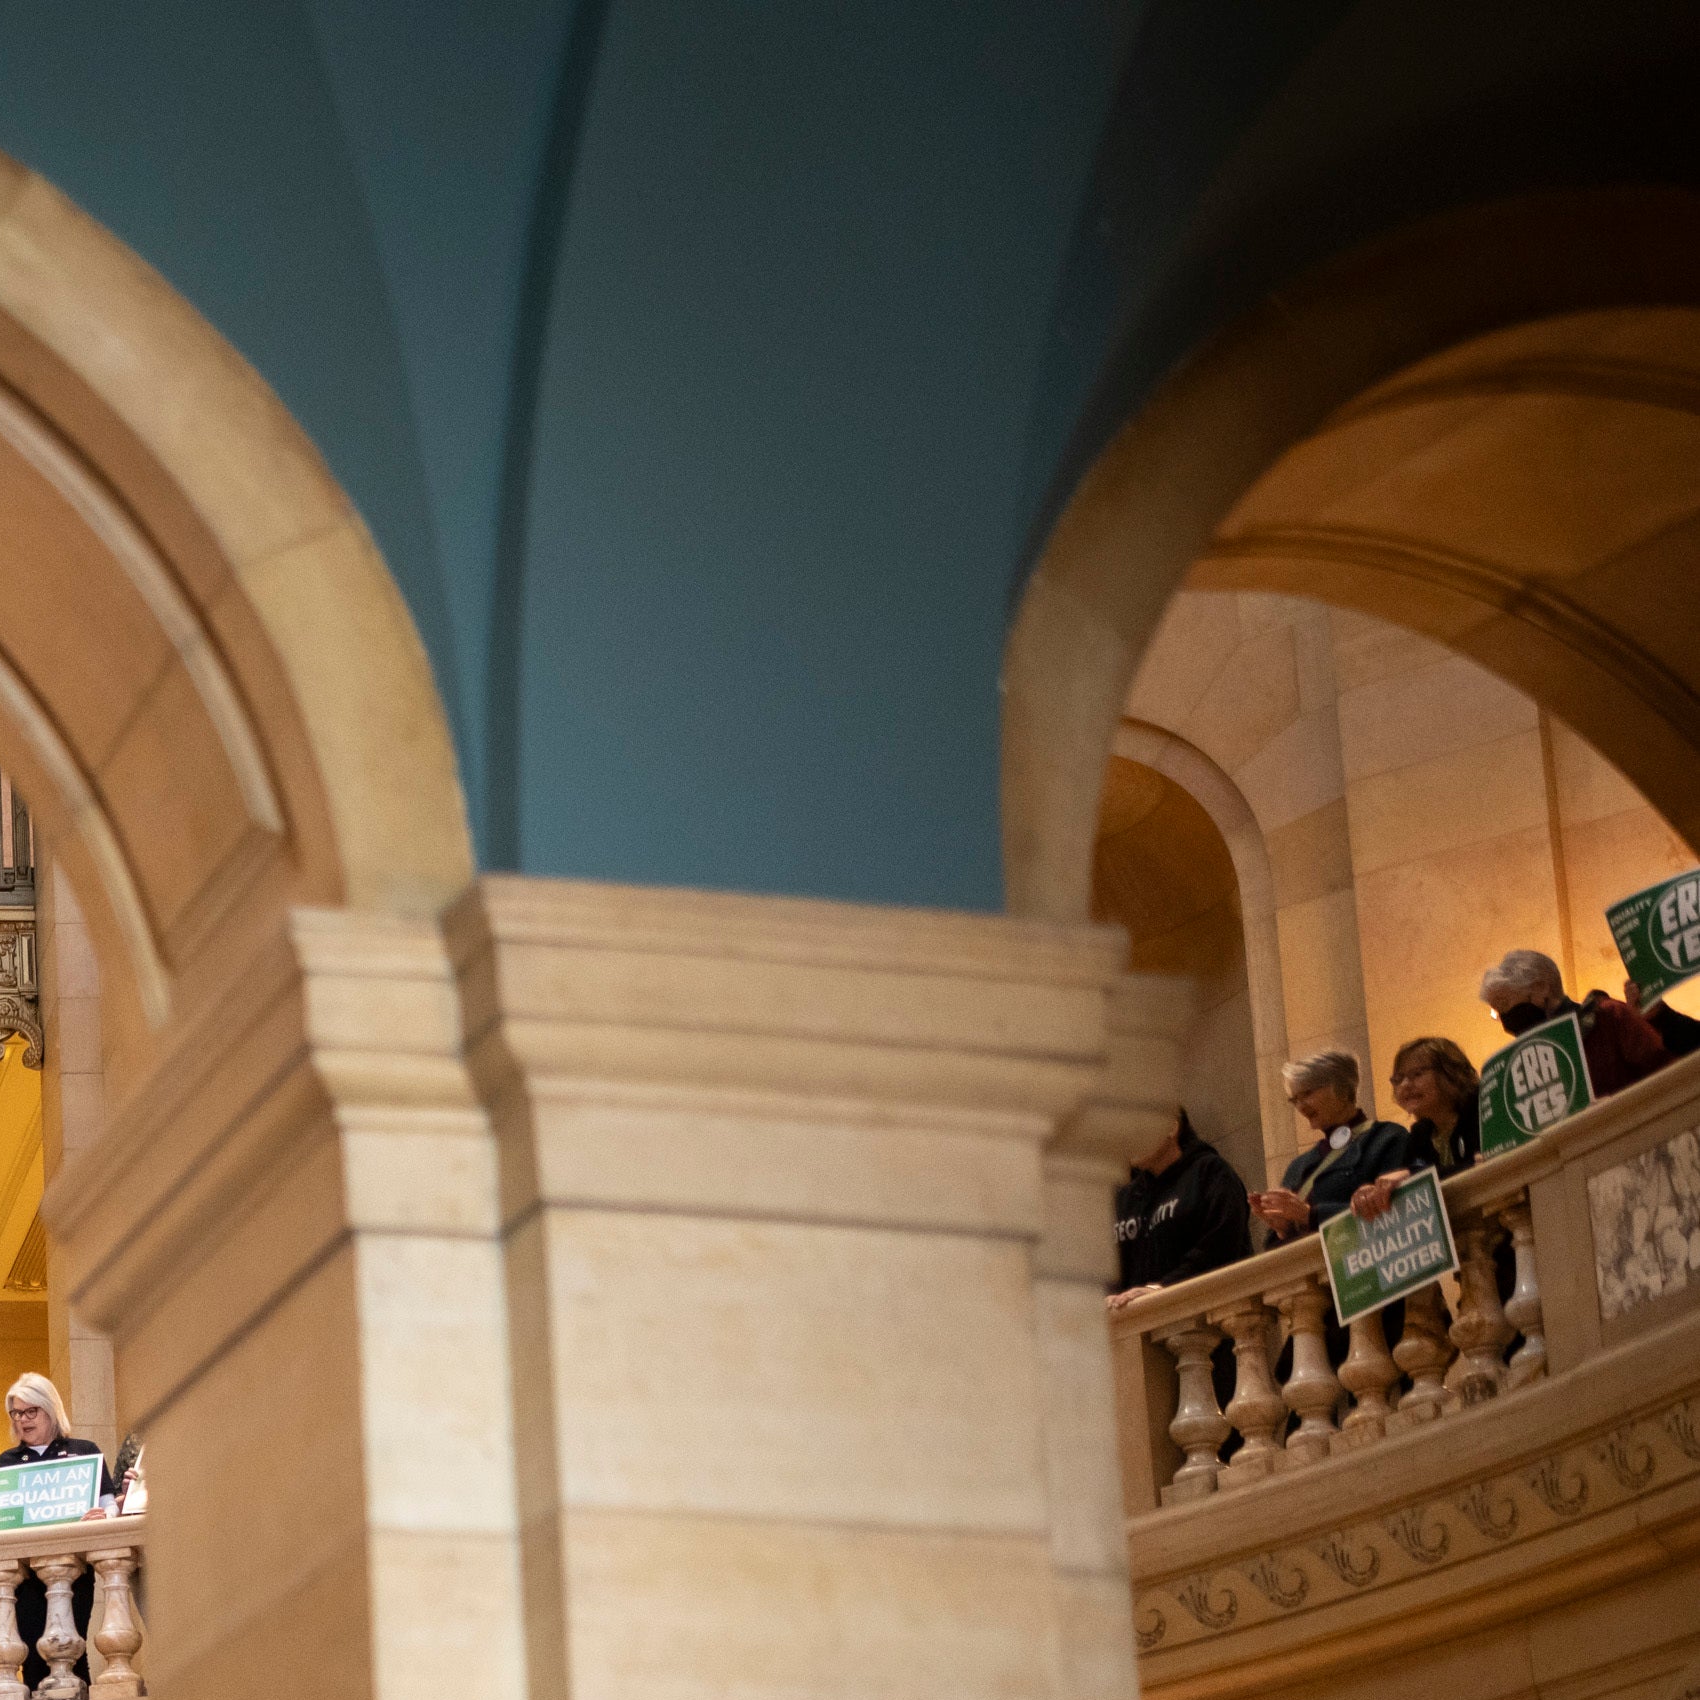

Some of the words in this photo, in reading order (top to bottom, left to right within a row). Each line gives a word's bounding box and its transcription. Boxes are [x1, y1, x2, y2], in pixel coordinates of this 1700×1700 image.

[1660, 880, 1700, 935] ER
[1661, 925, 1700, 969] YE
[1511, 1044, 1559, 1098] ERA
[1514, 1082, 1568, 1130] YES
[1405, 1189, 1431, 1217] AN
[1347, 1214, 1435, 1275] EQUALITY
[1380, 1241, 1445, 1284] VOTER
[0, 1483, 90, 1507] EQUALITY
[21, 1474, 26, 1488] I
[31, 1470, 59, 1487] AM
[65, 1466, 91, 1480] AN
[28, 1500, 88, 1521] VOTER
